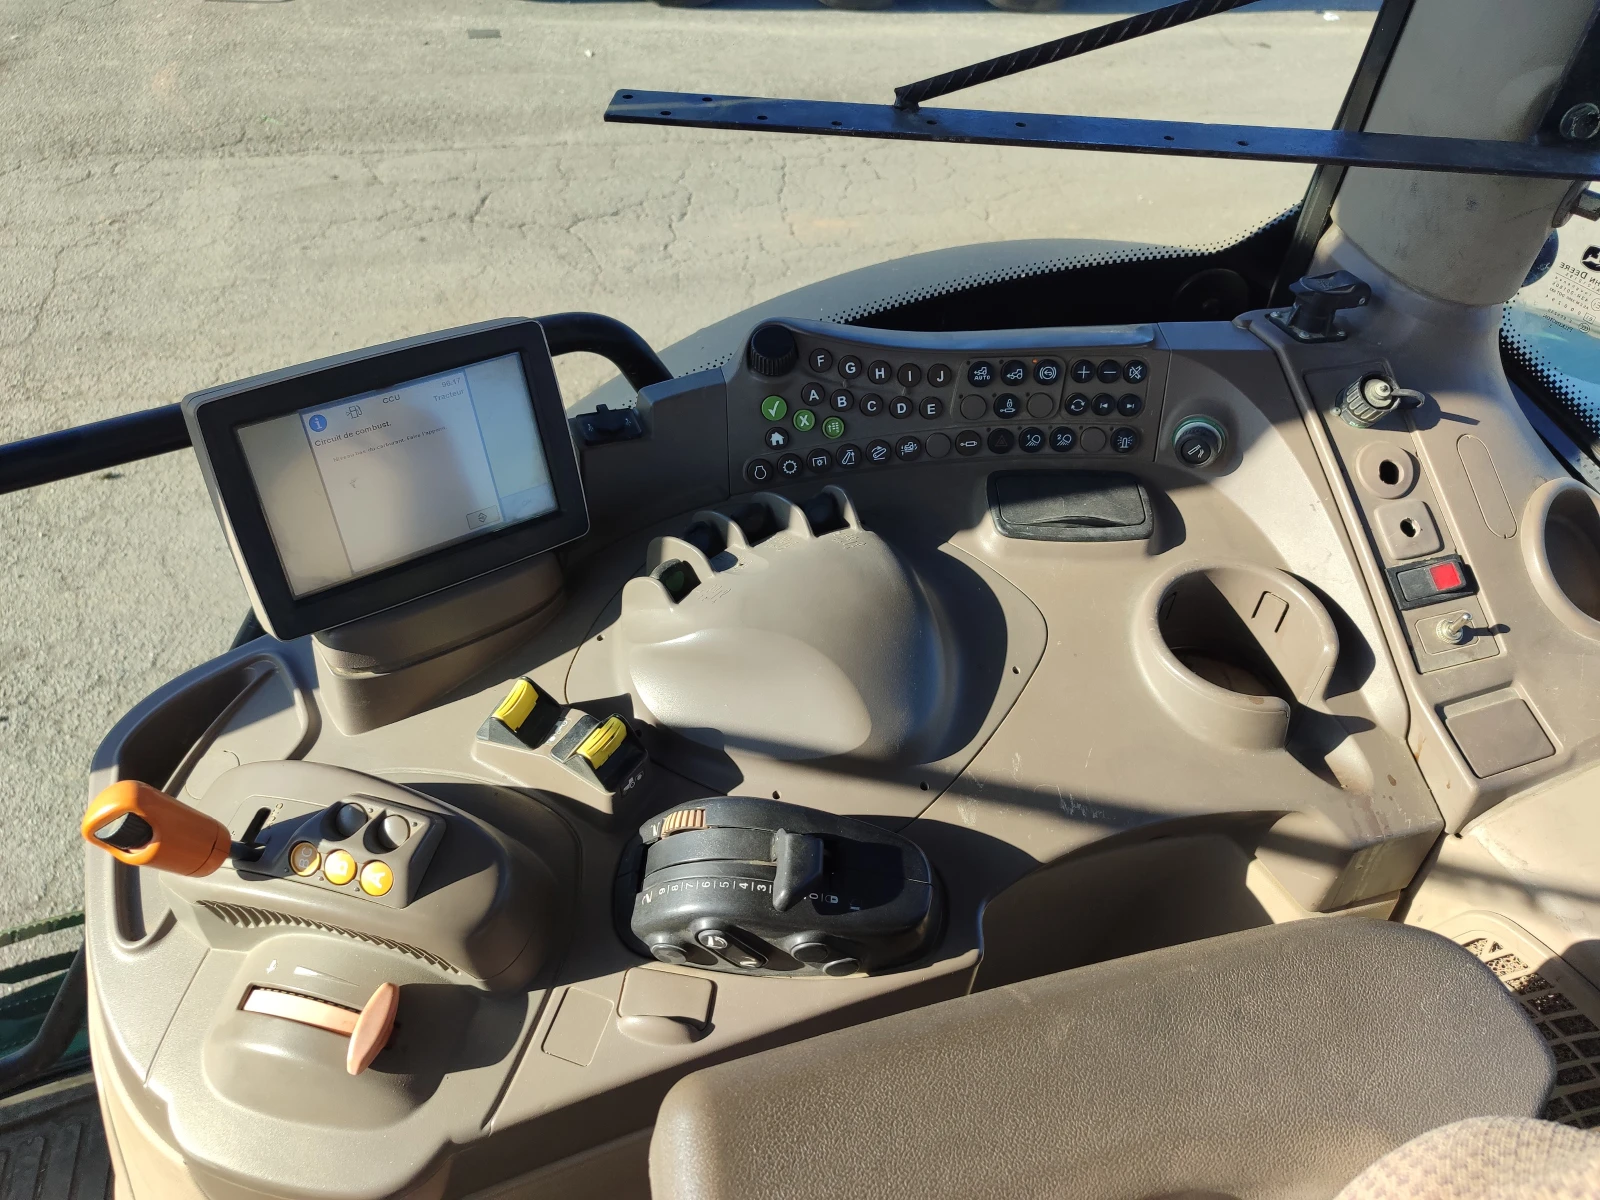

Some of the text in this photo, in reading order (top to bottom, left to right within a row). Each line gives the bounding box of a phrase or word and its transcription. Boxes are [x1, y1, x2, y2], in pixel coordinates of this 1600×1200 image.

[817, 355, 944, 382] F G H I J
[382, 394, 401, 404] CCU
[433, 389, 465, 402] Tracteur
[809, 389, 936, 415] A B C D E
[314, 421, 392, 447] Circuit de combust.
[368, 872, 386, 889] A
[671, 884, 679, 892] 8
[756, 884, 767, 892] 3
